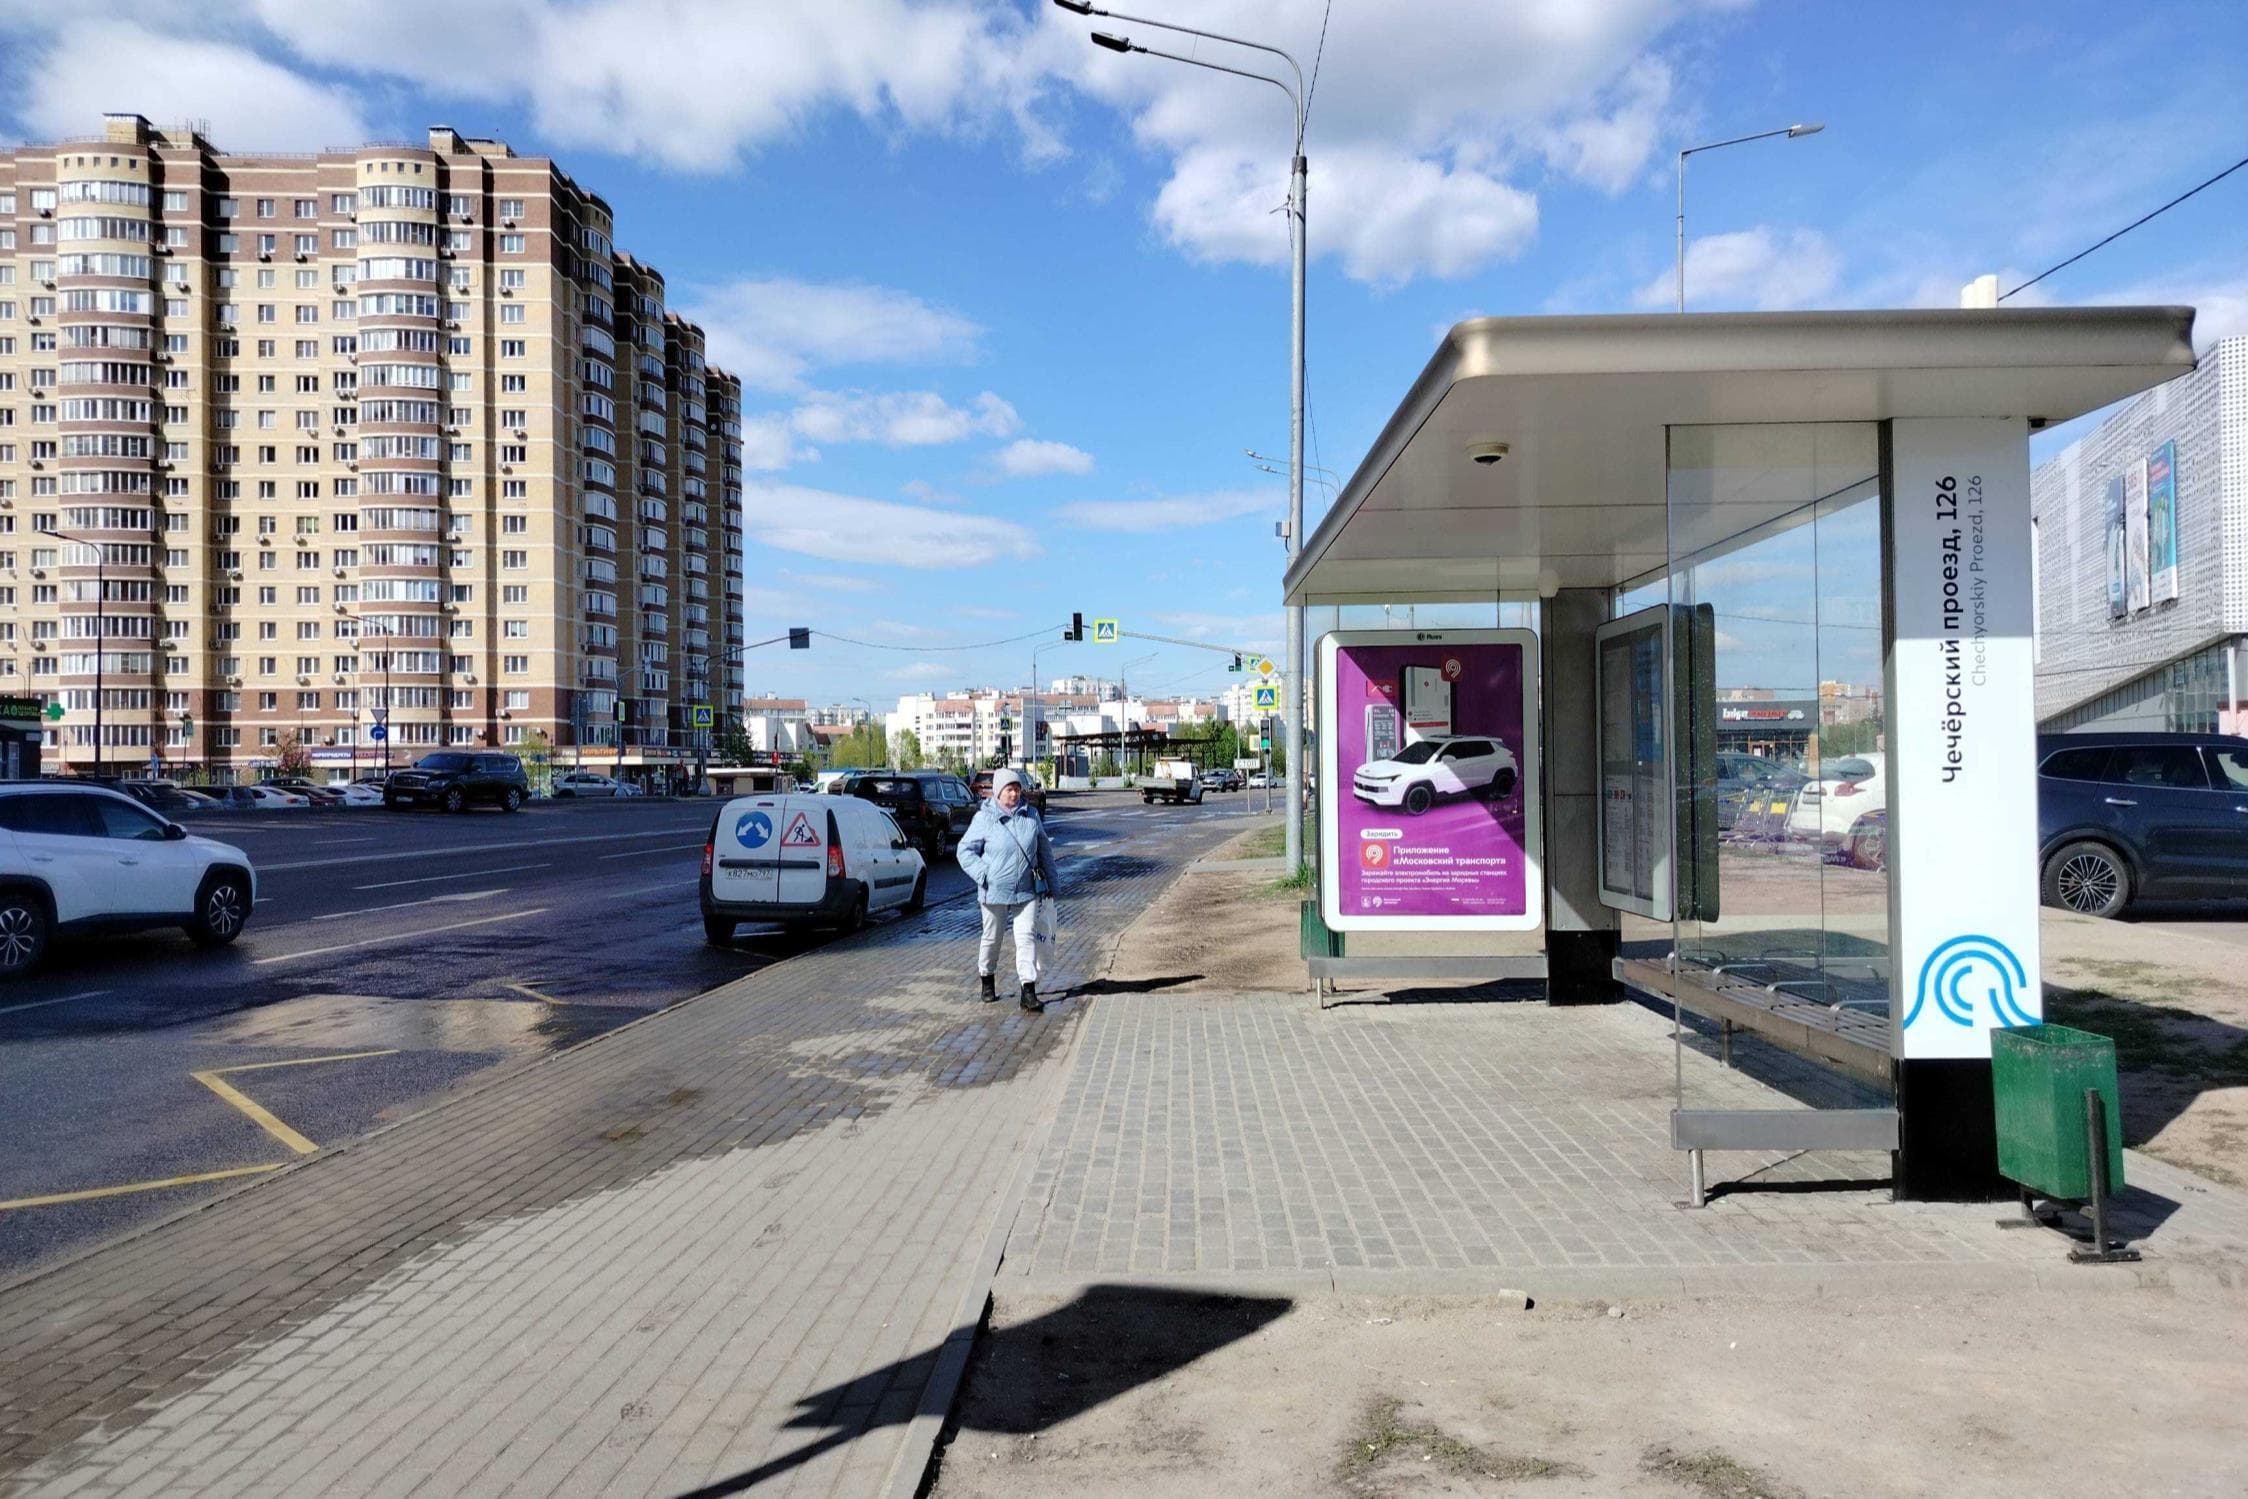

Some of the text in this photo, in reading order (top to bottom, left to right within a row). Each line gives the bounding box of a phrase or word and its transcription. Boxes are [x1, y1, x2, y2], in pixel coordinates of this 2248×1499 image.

[1936, 475, 1966, 784] Чечёрский проезд, 126
[1968, 474, 1989, 687] Chechyorskiy Proezd, 126
[1366, 830, 1399, 838] Зарядить
[1393, 846, 1450, 856] Приложение
